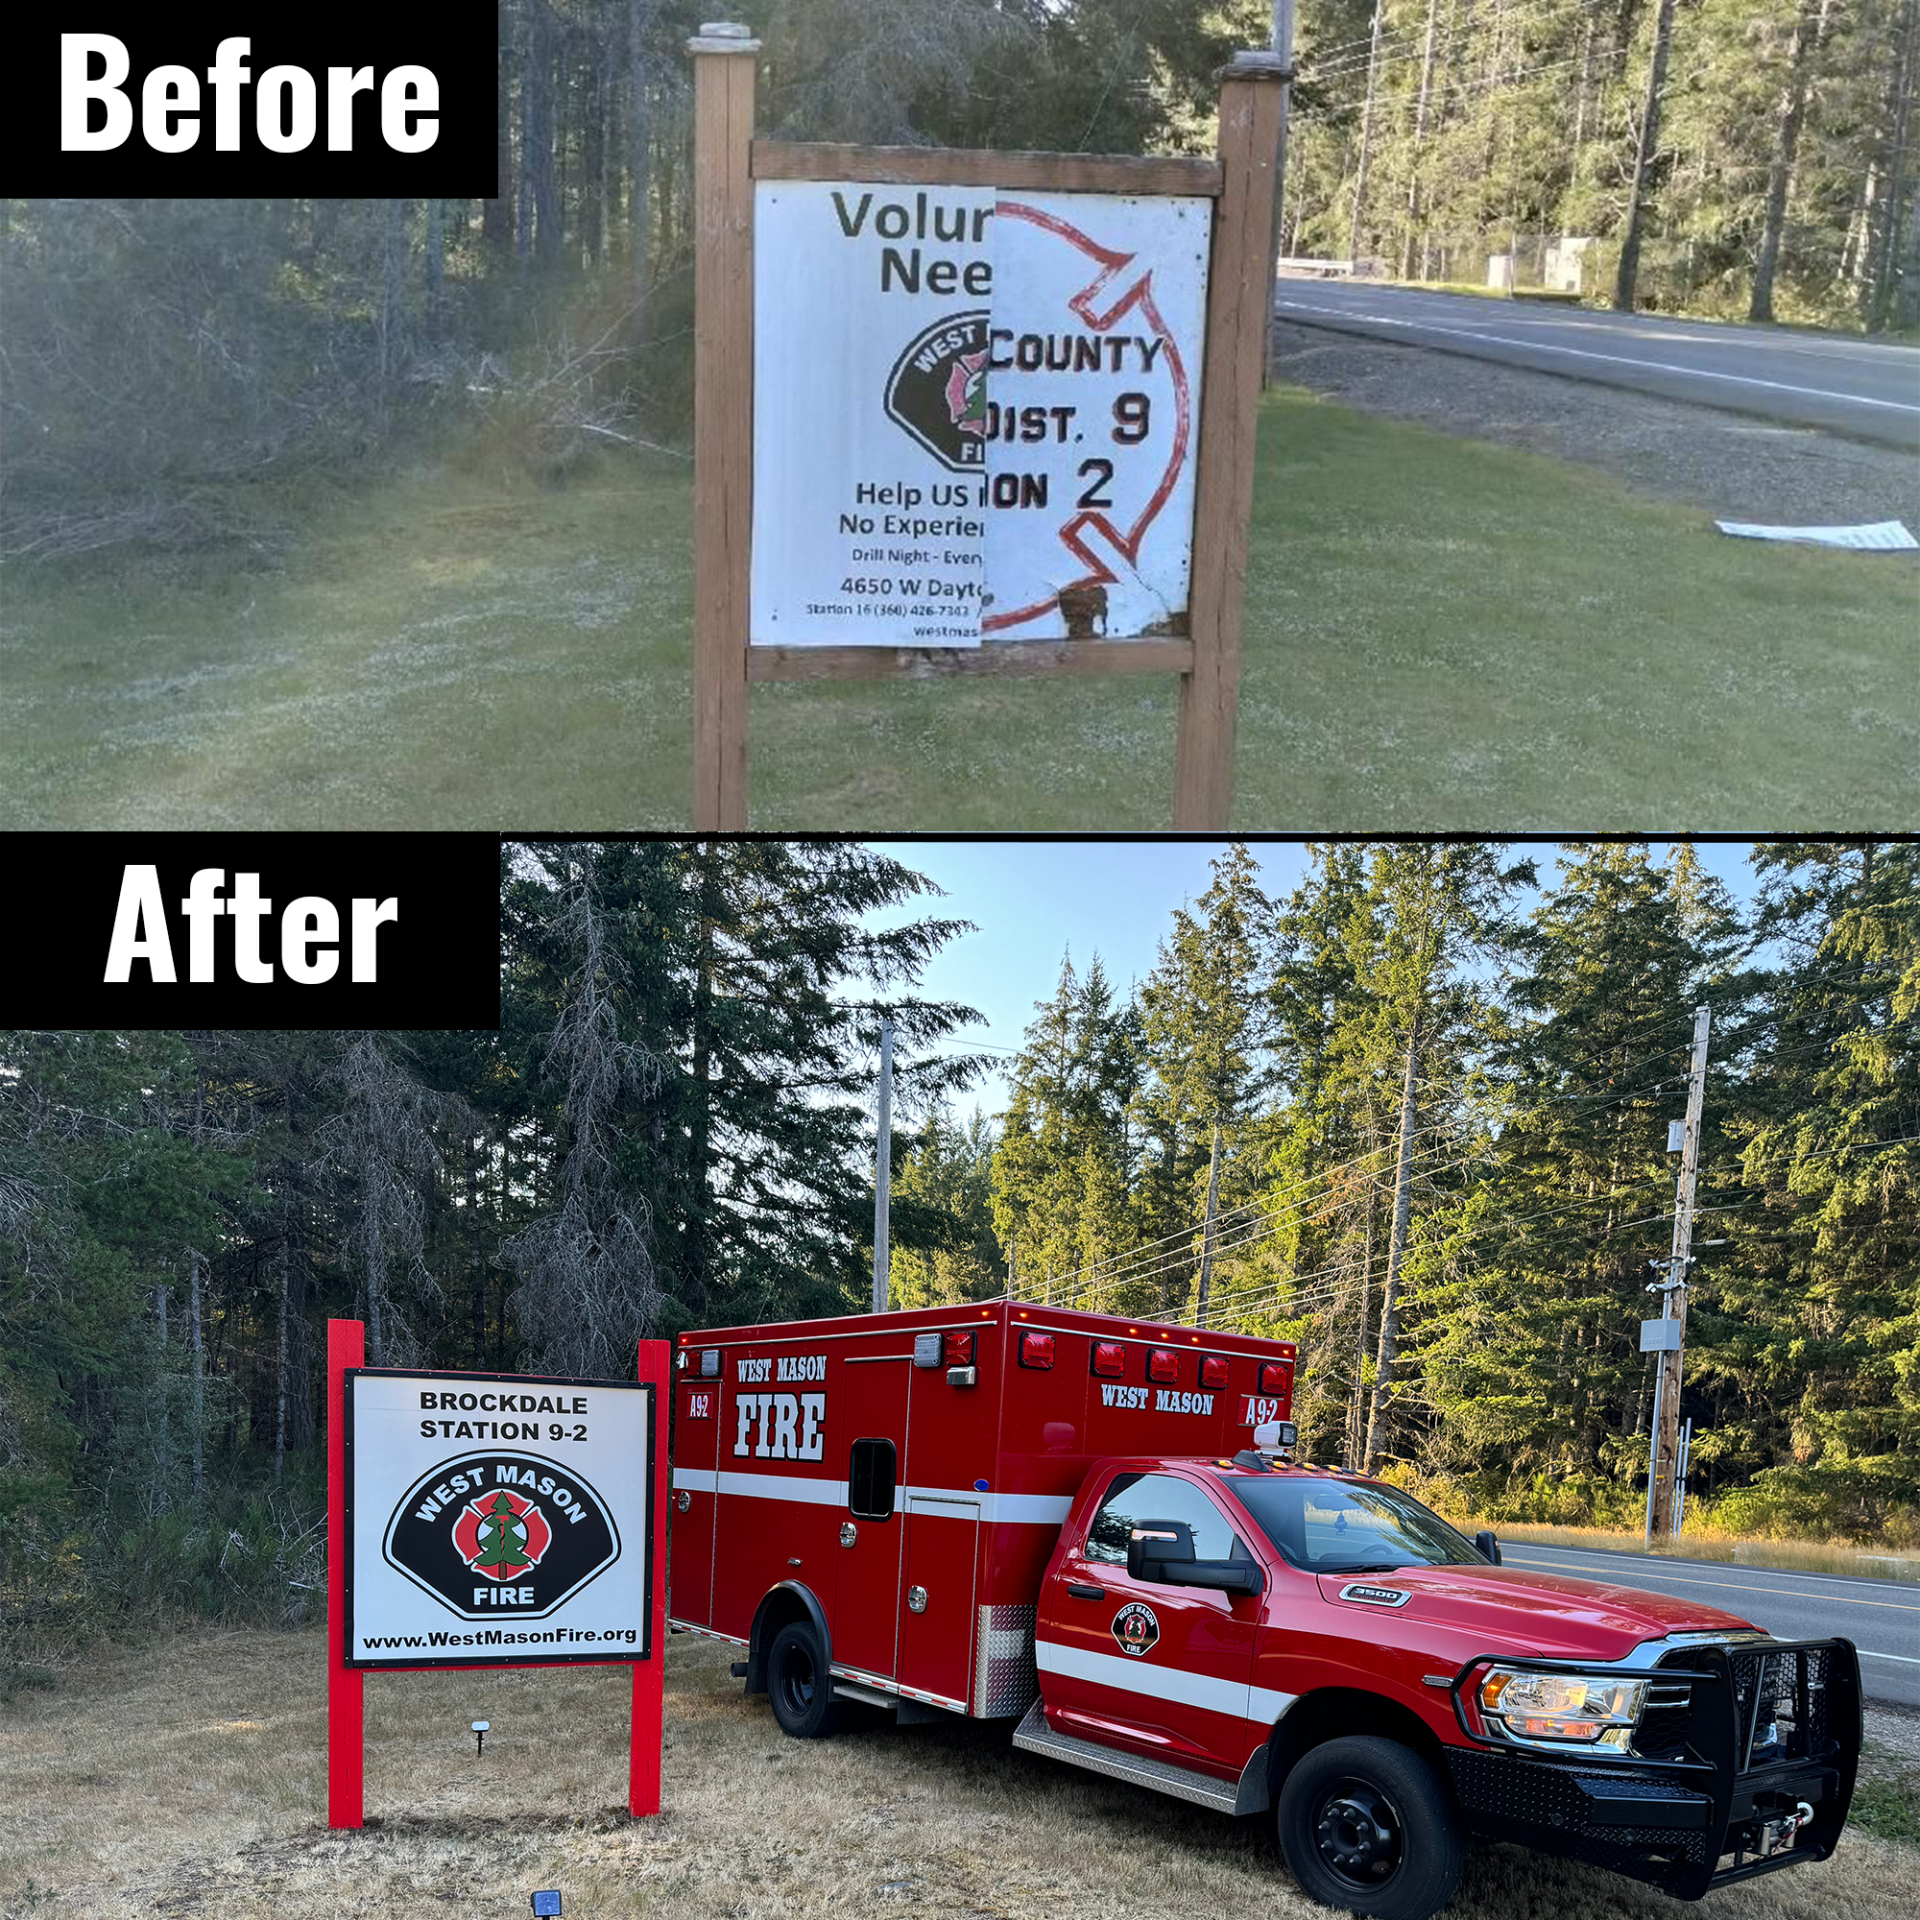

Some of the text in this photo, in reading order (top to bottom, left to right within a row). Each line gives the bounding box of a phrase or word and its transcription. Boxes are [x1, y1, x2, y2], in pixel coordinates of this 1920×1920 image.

[881, 247, 993, 296] Nee
[914, 325, 976, 373] WEST
[989, 328, 1165, 373] COUNTY
[1112, 392, 1151, 445] 9
[1077, 458, 1114, 509] 2
[856, 481, 922, 511] Help
[931, 484, 969, 508] US
[839, 513, 875, 535] No
[852, 549, 884, 562] Drill
[888, 549, 930, 566] Night
[840, 577, 893, 596] 4650
[899, 579, 922, 596] W
[806, 604, 853, 615] Station
[737, 1355, 827, 1383] WEST MASON
[419, 1391, 588, 1415] BROCKDALE
[1101, 1383, 1215, 1416] WEST MASON
[419, 1420, 588, 1442] STATION 9-2
[733, 1392, 827, 1462] FIRE
[415, 1465, 588, 1525] WEST MASON
[473, 1586, 535, 1606] FIRE
[1354, 1587, 1398, 1599] 3500
[1117, 1605, 1156, 1627] WEST MASON
[362, 1628, 637, 1649] www.WestMasonFire.org
[1126, 1644, 1141, 1653] FIRE
